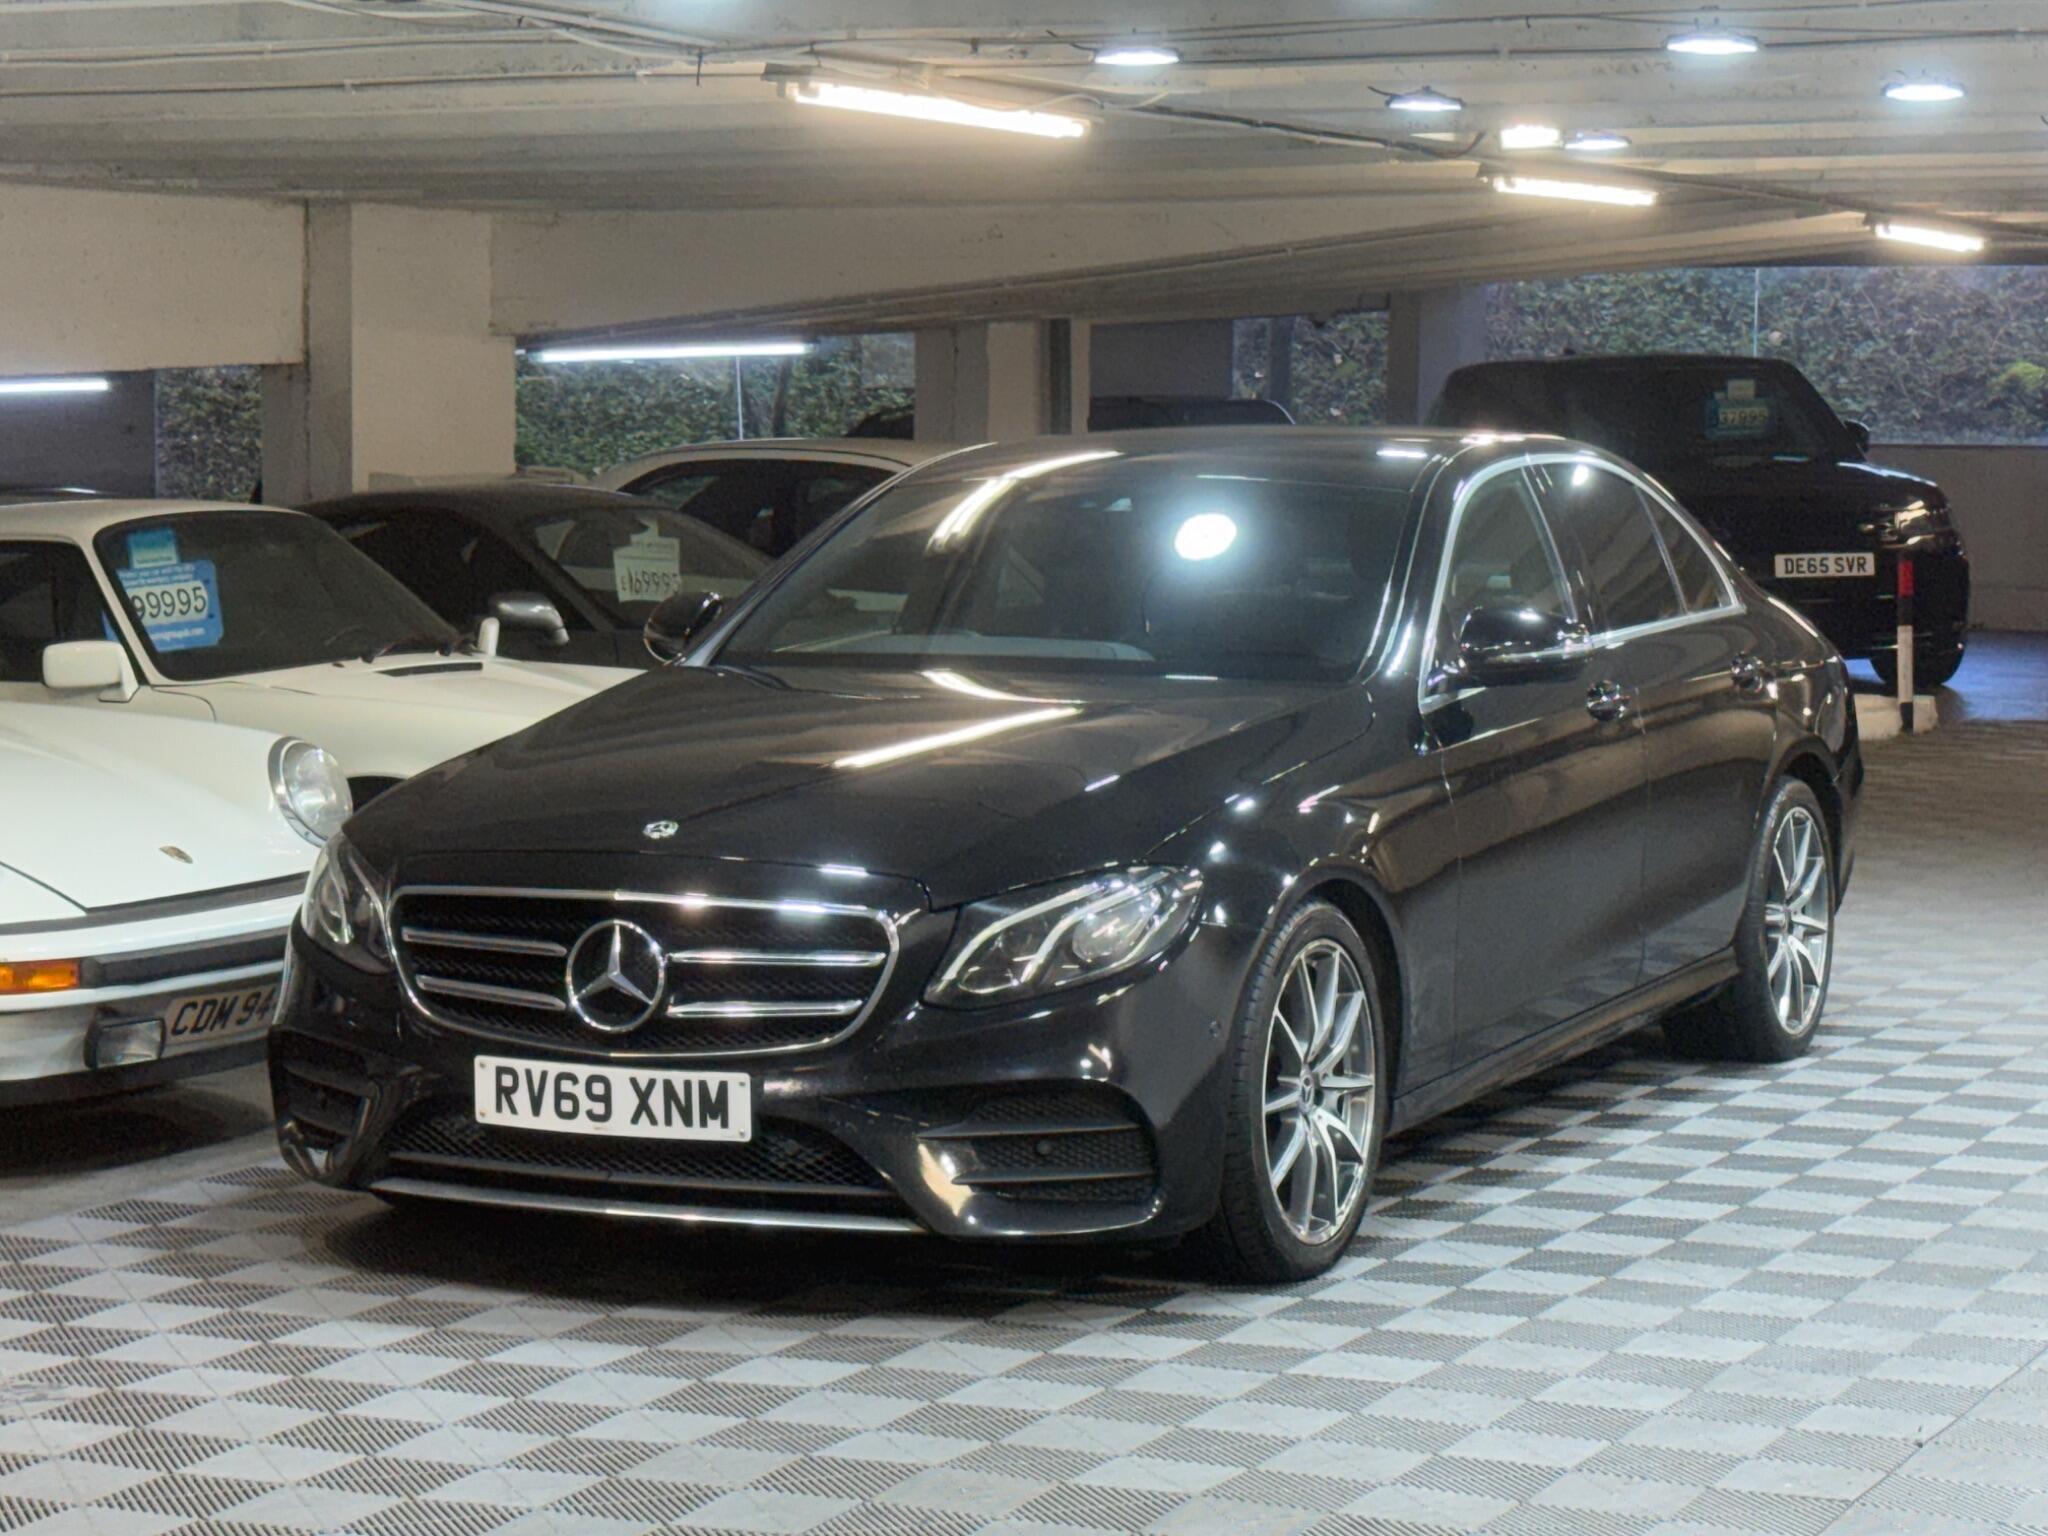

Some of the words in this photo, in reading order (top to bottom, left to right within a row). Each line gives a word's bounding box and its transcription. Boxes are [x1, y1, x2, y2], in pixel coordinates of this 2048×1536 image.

[1784, 557, 1829, 574] DE65
[1834, 556, 1867, 572] SVR
[171, 995, 239, 1036] CDM
[495, 1065, 613, 1123] RV69
[629, 1076, 730, 1129] XNM
